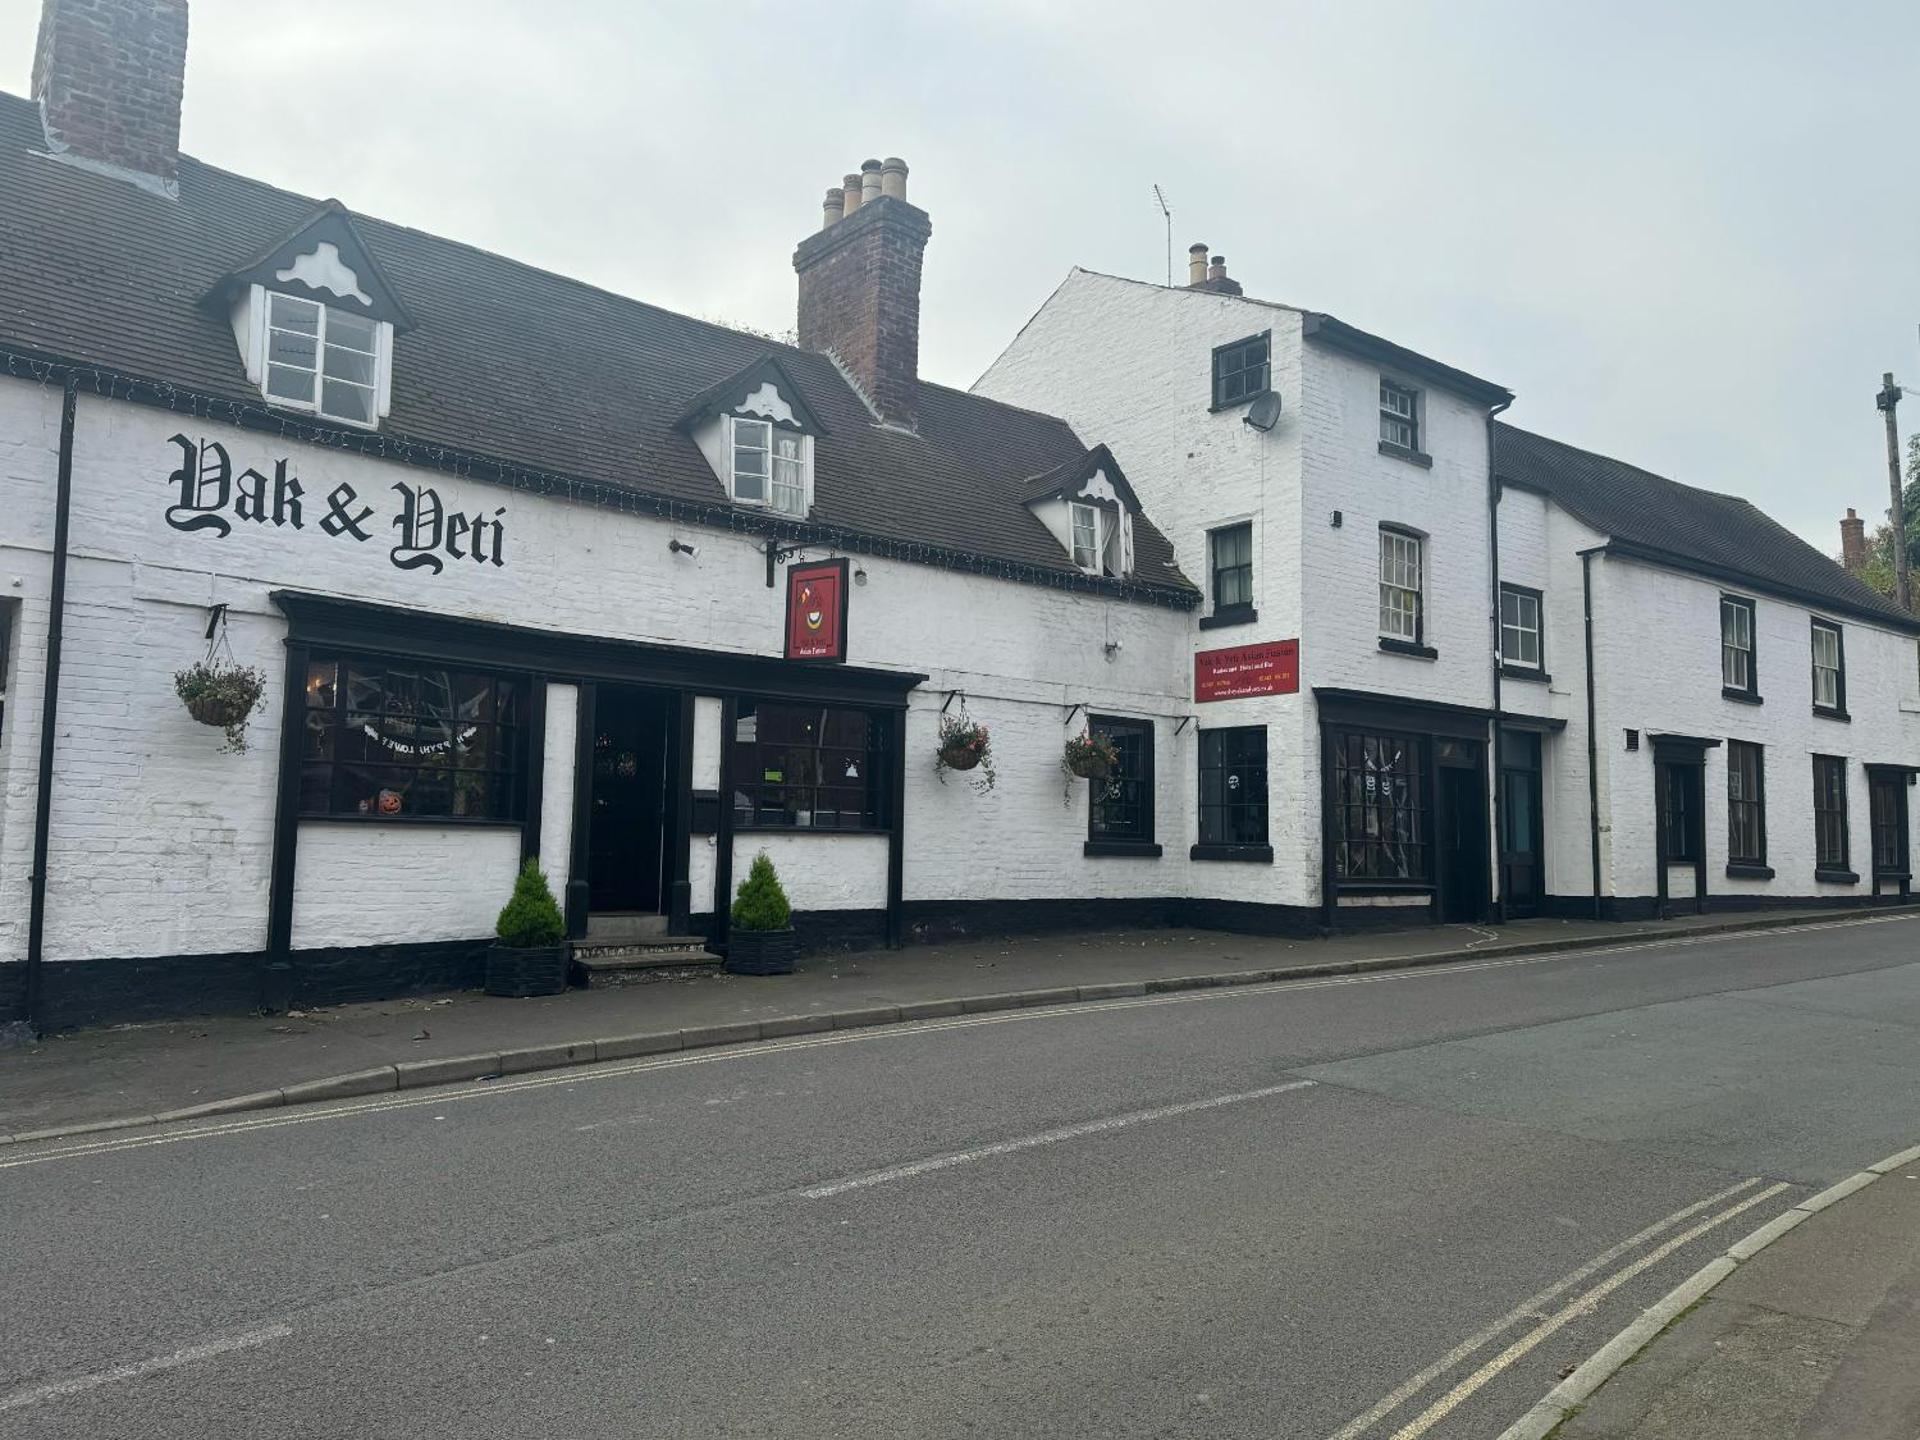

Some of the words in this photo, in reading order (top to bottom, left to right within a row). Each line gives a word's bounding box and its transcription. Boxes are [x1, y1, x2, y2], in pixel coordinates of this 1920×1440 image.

[165, 433, 305, 539] Yak
[318, 481, 375, 542] &
[390, 481, 507, 576] Yeti
